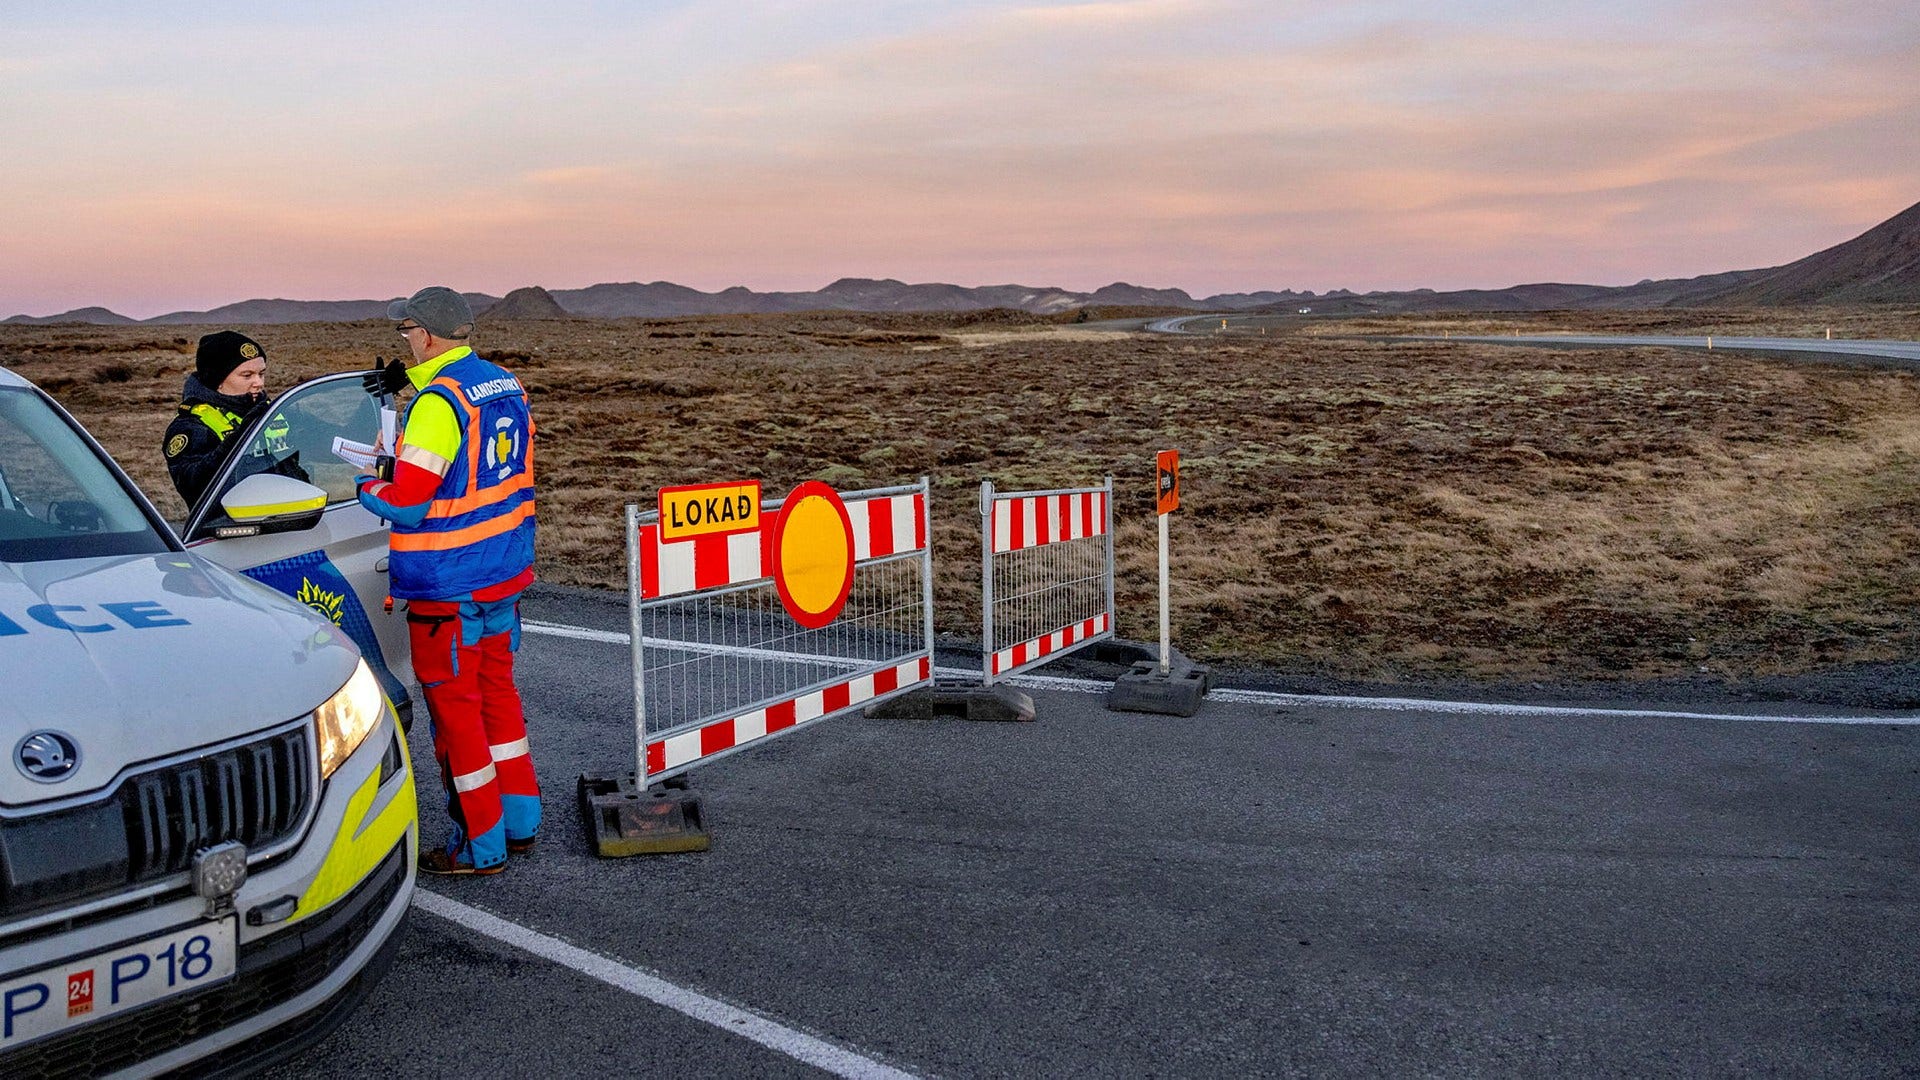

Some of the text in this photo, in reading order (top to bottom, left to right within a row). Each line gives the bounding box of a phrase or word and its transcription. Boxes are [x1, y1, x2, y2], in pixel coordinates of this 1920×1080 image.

[671, 495, 751, 528] LOKAÐ
[4, 935, 213, 1038] P P18
[70, 977, 90, 1001] 24
